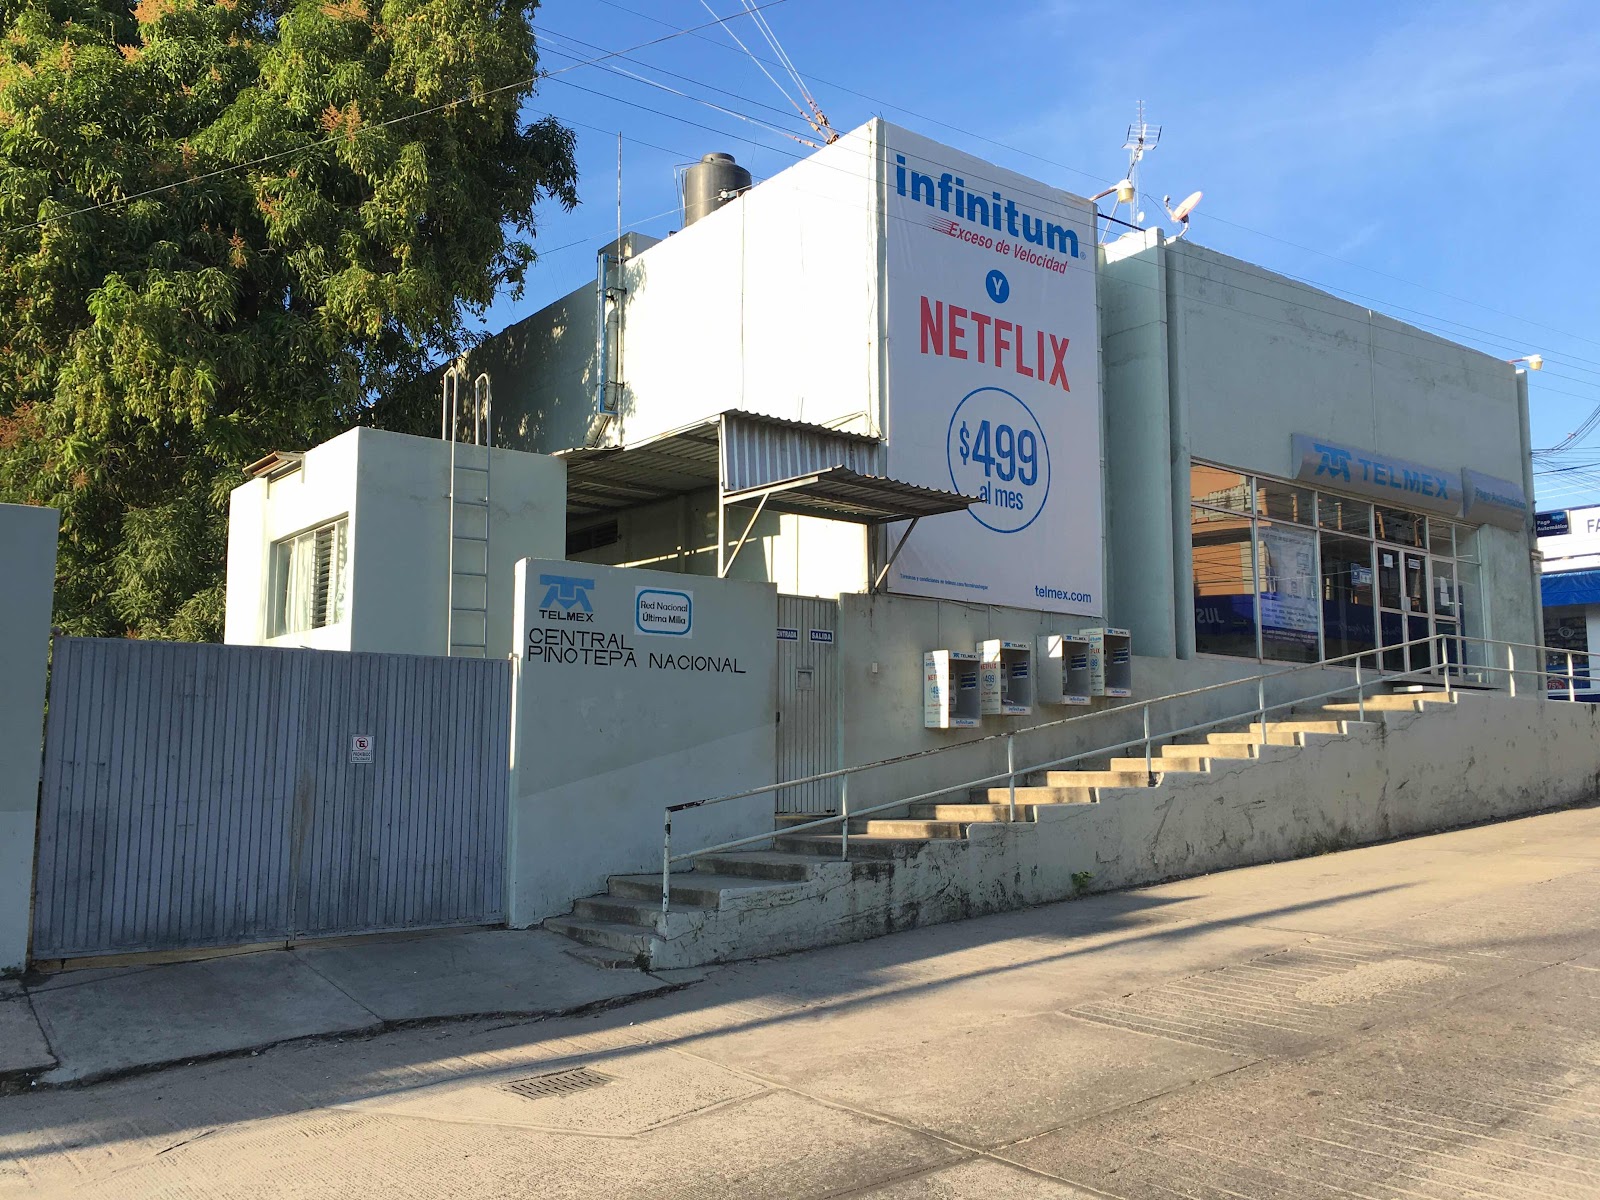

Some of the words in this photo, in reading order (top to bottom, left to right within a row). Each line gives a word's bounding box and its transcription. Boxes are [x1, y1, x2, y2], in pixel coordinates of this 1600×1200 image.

[896, 154, 1079, 259] infinitum
[949, 221, 993, 249] Exceso
[995, 239, 1010, 255] de
[1014, 243, 1068, 275] Velocidad
[920, 295, 1071, 393] NETFLIX
[959, 419, 1038, 487] $499
[1357, 457, 1449, 501] TELMEX
[979, 480, 991, 505] al
[994, 488, 1024, 511] mes
[640, 600, 655, 610] Red
[657, 601, 688, 613] Nacional
[1034, 584, 1092, 604] telmex.com
[539, 609, 594, 623] TELMEX
[642, 611, 667, 623] Última
[668, 615, 686, 625] Milla
[529, 627, 634, 651] CENTRAL
[777, 630, 797, 639] ENTRADA
[811, 631, 832, 641] SALIDA
[528, 645, 637, 668] PINOTEPA
[649, 652, 747, 674] NACIONAL
